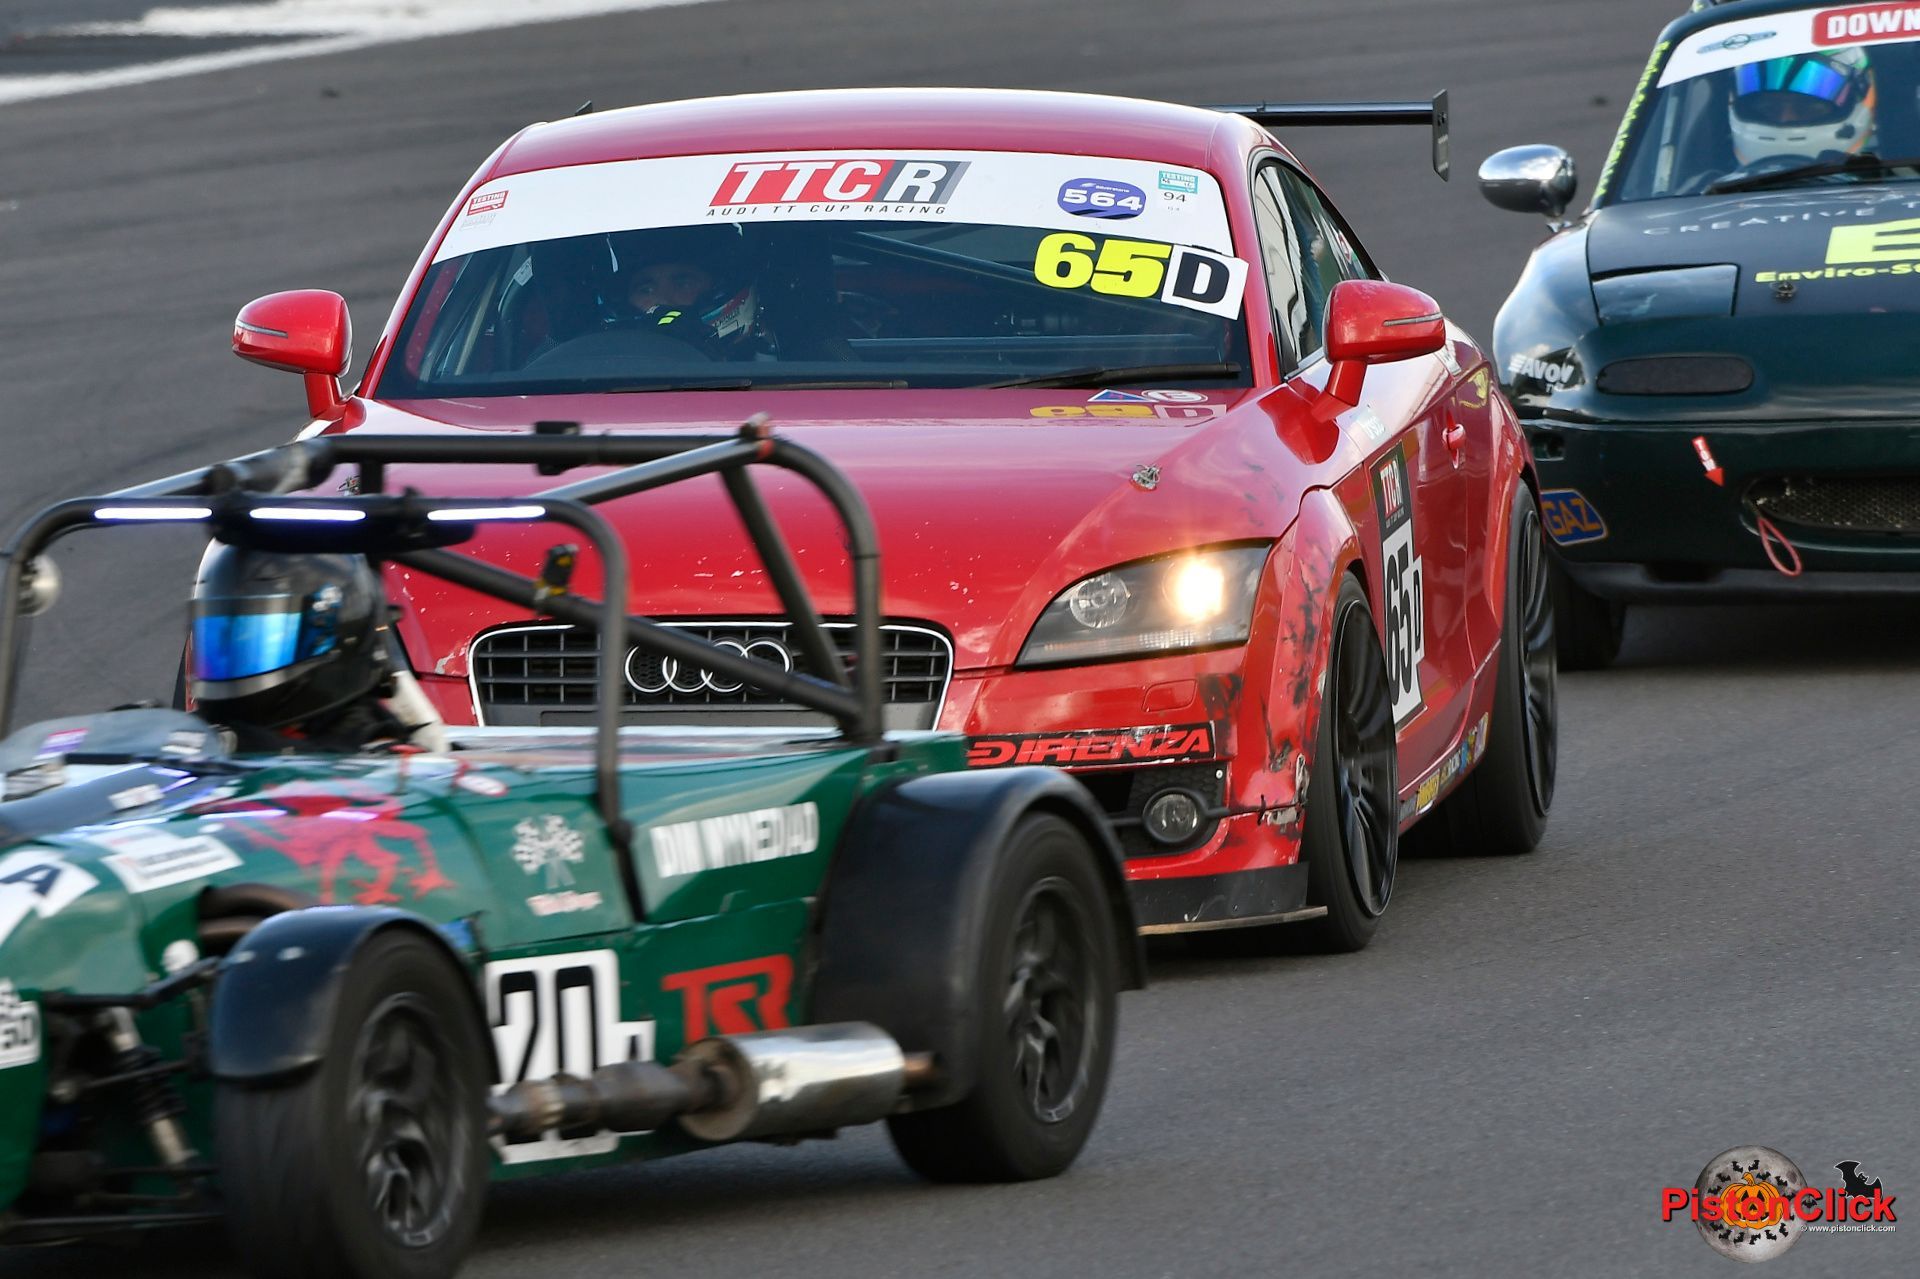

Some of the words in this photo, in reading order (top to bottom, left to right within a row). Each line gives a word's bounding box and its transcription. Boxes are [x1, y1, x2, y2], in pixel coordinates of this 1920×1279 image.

[729, 161, 948, 203] TTCR
[1063, 189, 1143, 211] 564
[1164, 191, 1185, 203] 94
[706, 205, 757, 217] AUDI
[774, 205, 797, 213] TT
[810, 204, 850, 213] CUP
[865, 204, 946, 215] RACING
[1034, 232, 1172, 298] 65
[1173, 251, 1230, 304] D
[1543, 498, 1600, 536] GAZ
[1387, 541, 1412, 706] 65
[967, 728, 1211, 768] DIRENZA
